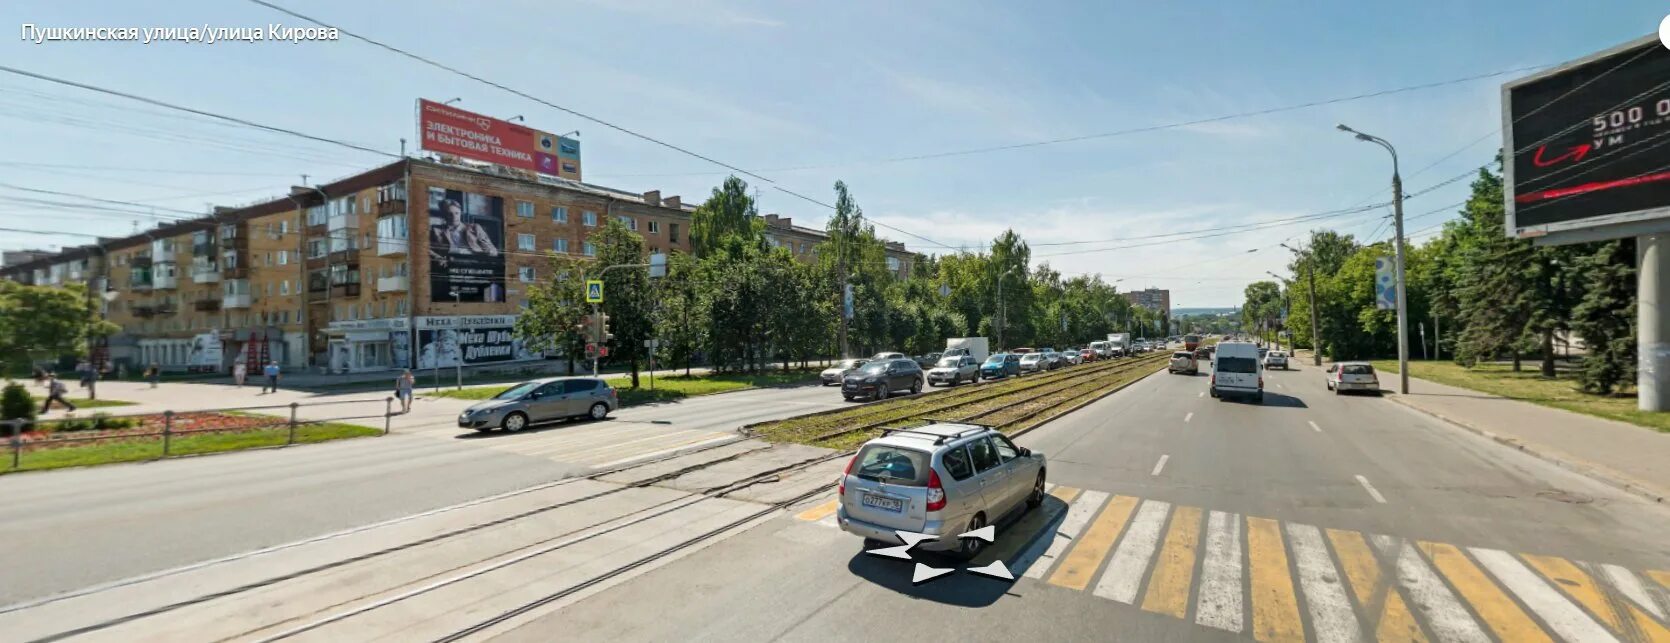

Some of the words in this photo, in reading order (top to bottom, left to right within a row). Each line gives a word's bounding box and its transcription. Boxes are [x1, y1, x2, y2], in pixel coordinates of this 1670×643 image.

[1593, 107, 1643, 131] 500
[426, 121, 501, 145] ЭЛЕКТРОНИКА
[426, 131, 436, 141] И
[437, 133, 489, 153] БЫТОВАЯ
[491, 145, 532, 162] ТЕХНИКА
